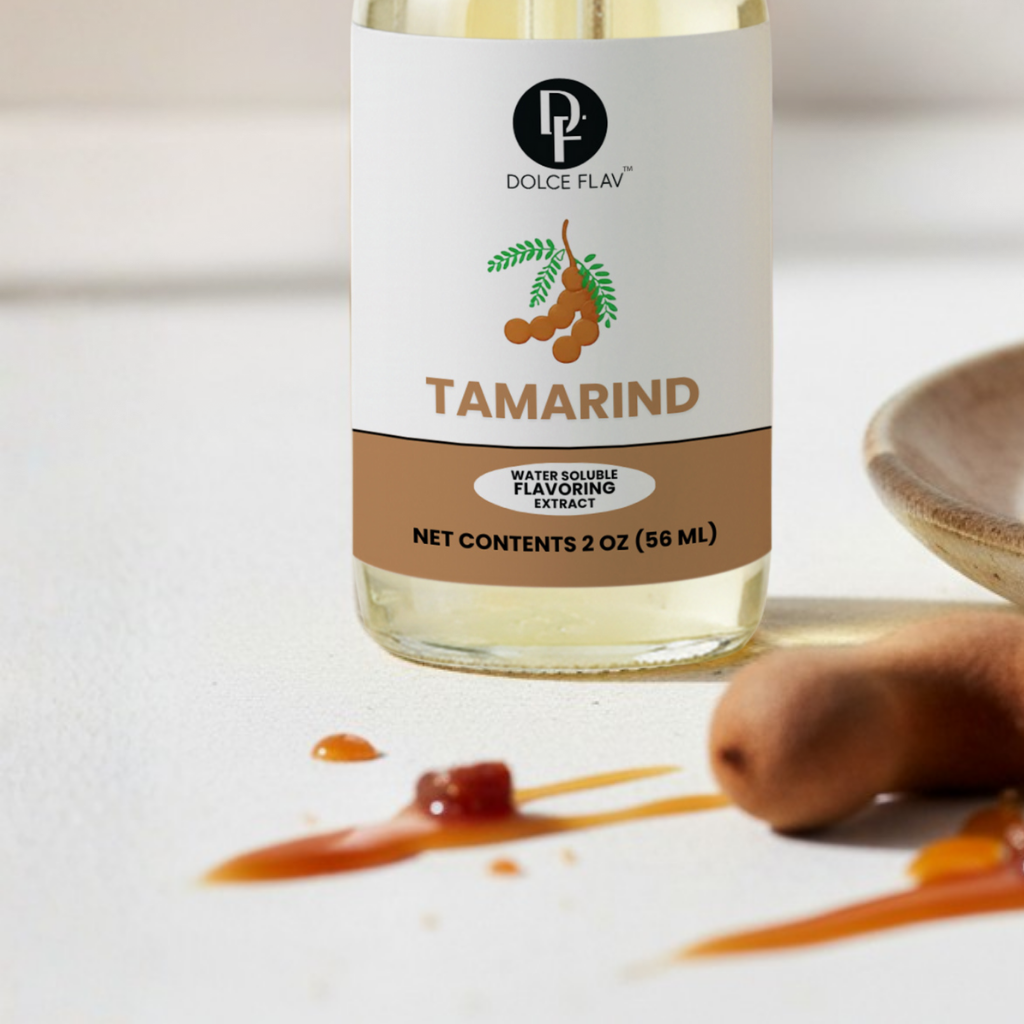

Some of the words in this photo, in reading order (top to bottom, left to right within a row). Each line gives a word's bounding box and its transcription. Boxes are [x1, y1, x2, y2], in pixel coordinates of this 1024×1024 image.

[506, 173, 571, 190] DOLCE
[577, 172, 624, 189] FLAV
[425, 376, 700, 421] TAMARIND
[510, 469, 558, 481] WATER
[561, 469, 618, 481] SOLUBLE
[513, 480, 616, 496] FLAVORING
[533, 497, 596, 509] EXTRACT
[412, 527, 454, 548] NET
[458, 532, 577, 553] CONTENTS
[581, 534, 594, 552] 2
[599, 534, 629, 552] OZ
[634, 528, 672, 554] (56
[677, 521, 717, 547] ML)
